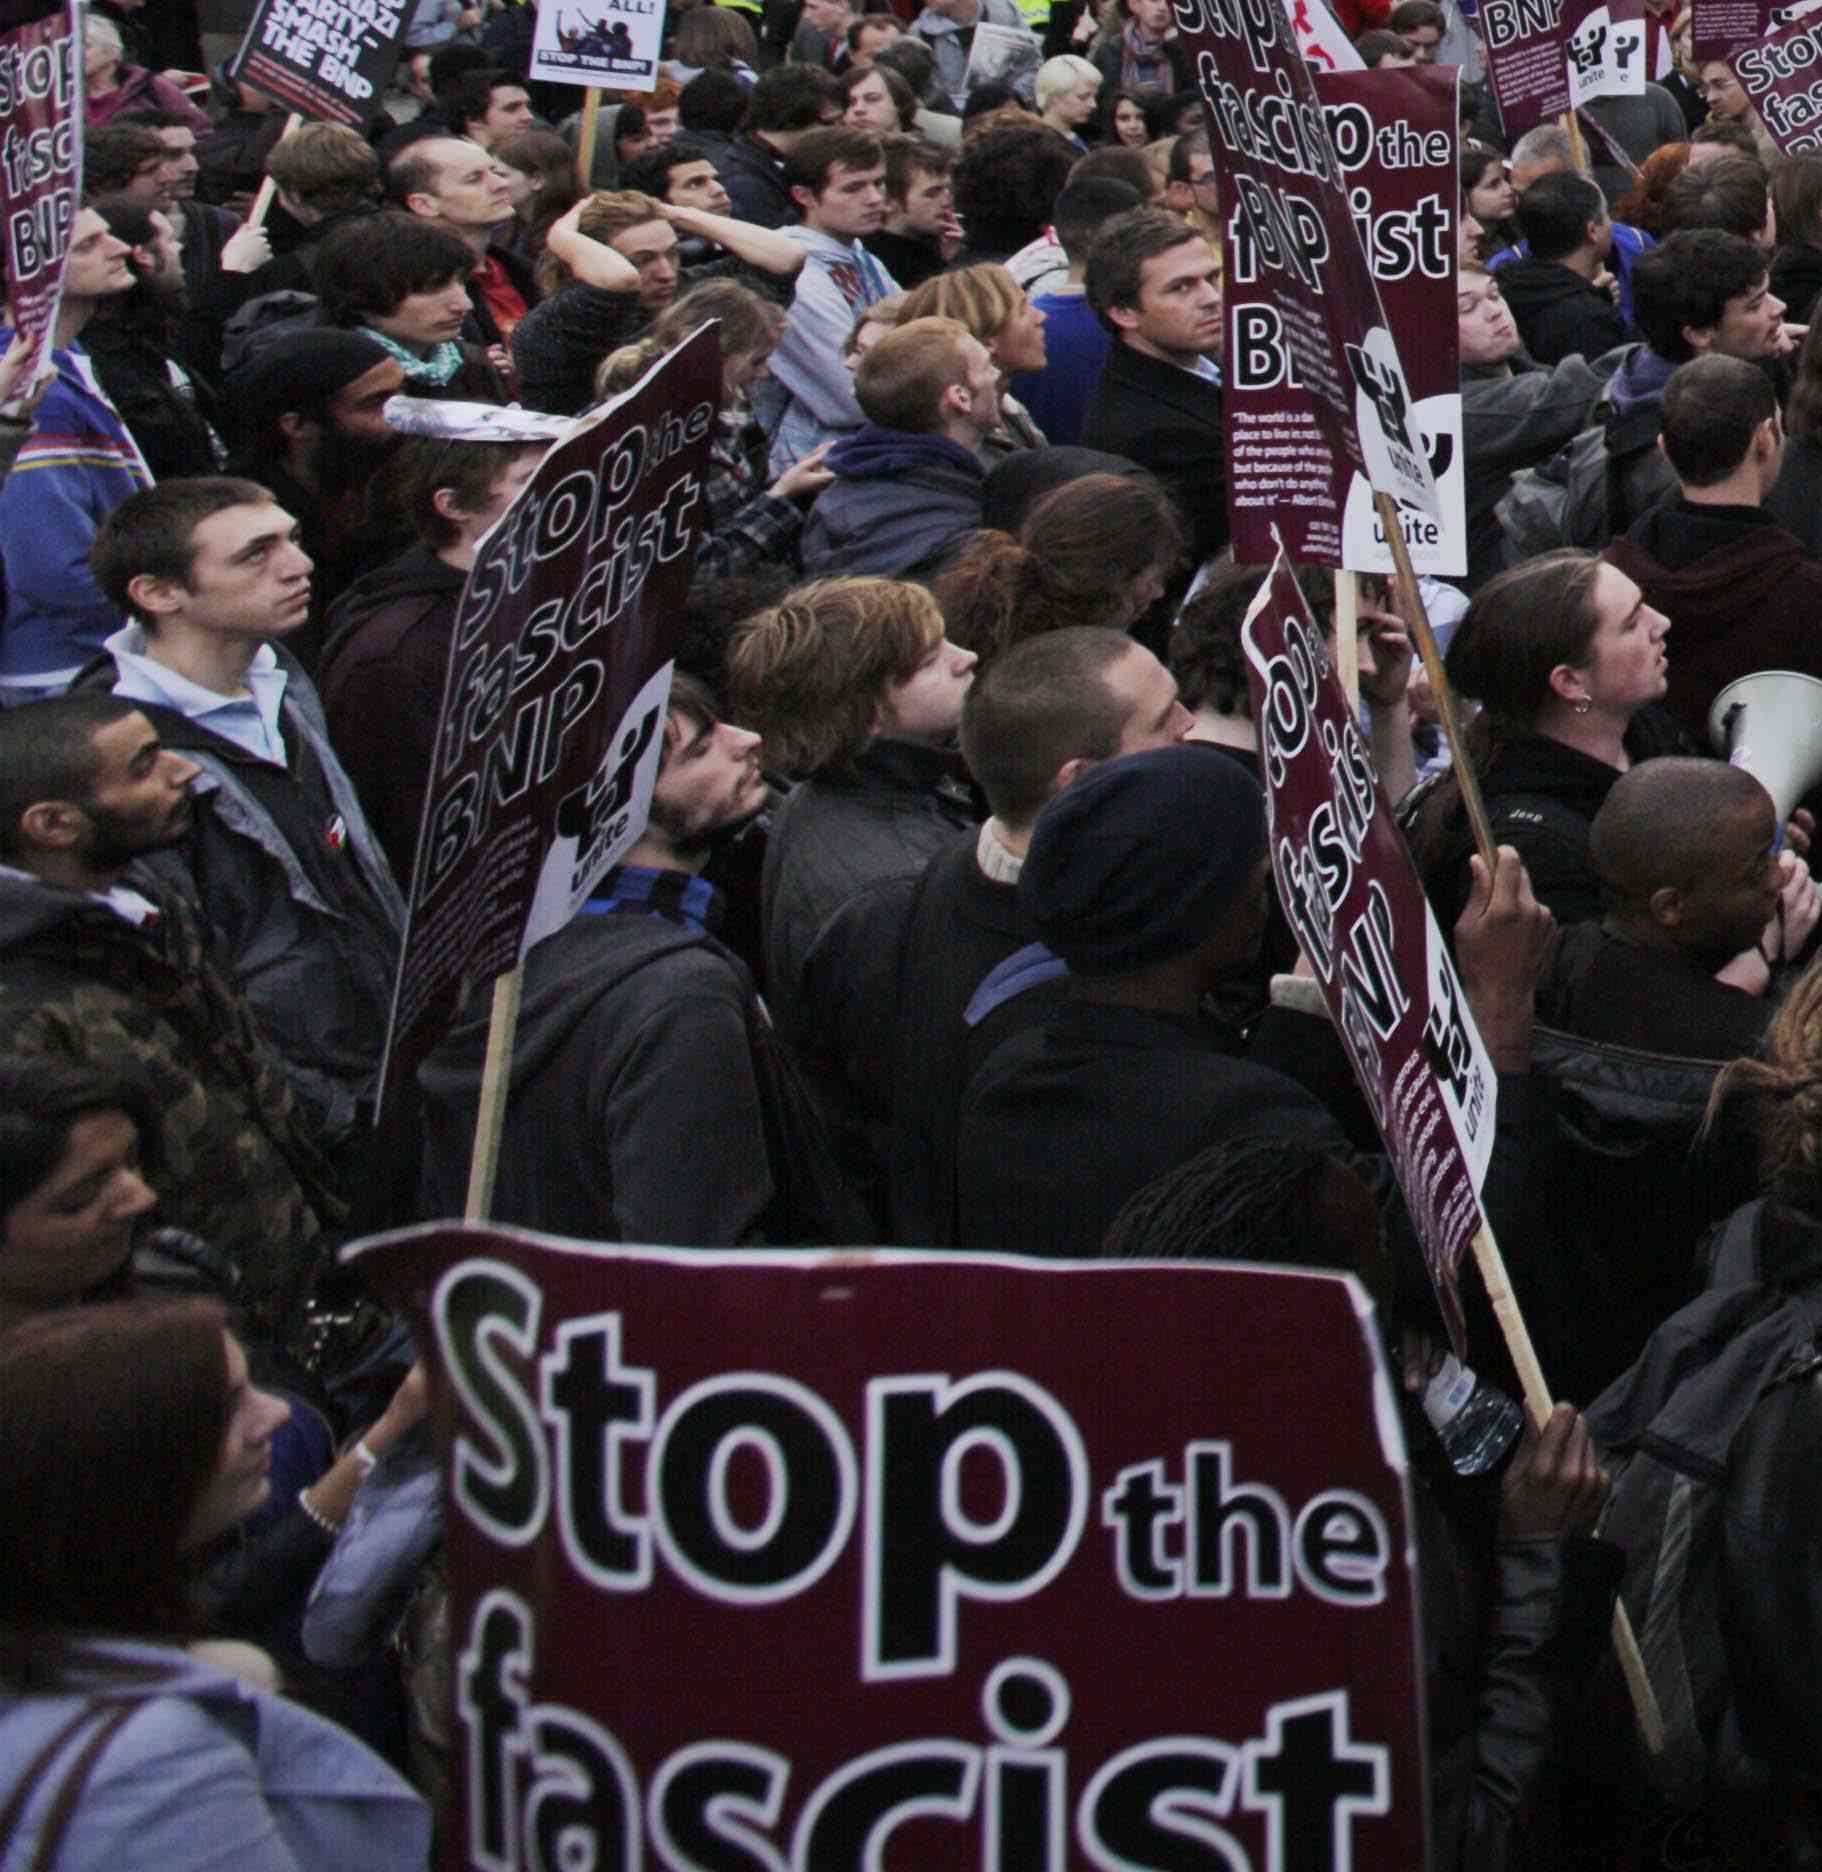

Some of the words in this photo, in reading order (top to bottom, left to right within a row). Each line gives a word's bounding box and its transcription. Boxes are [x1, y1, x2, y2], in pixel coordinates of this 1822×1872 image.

[263, 21, 314, 65] THE
[318, 58, 373, 99] BNP
[272, 0, 361, 66] SMASH
[608, 0, 654, 14] ALL!
[1577, 68, 1606, 89] unite
[442, 473, 700, 776] fascist
[460, 417, 647, 651] Stop
[647, 401, 713, 471] the
[430, 658, 605, 876] BNP
[434, 1258, 1089, 1682] Stop
[1104, 1440, 1390, 1605] the
[457, 1590, 1390, 1872] fascist
